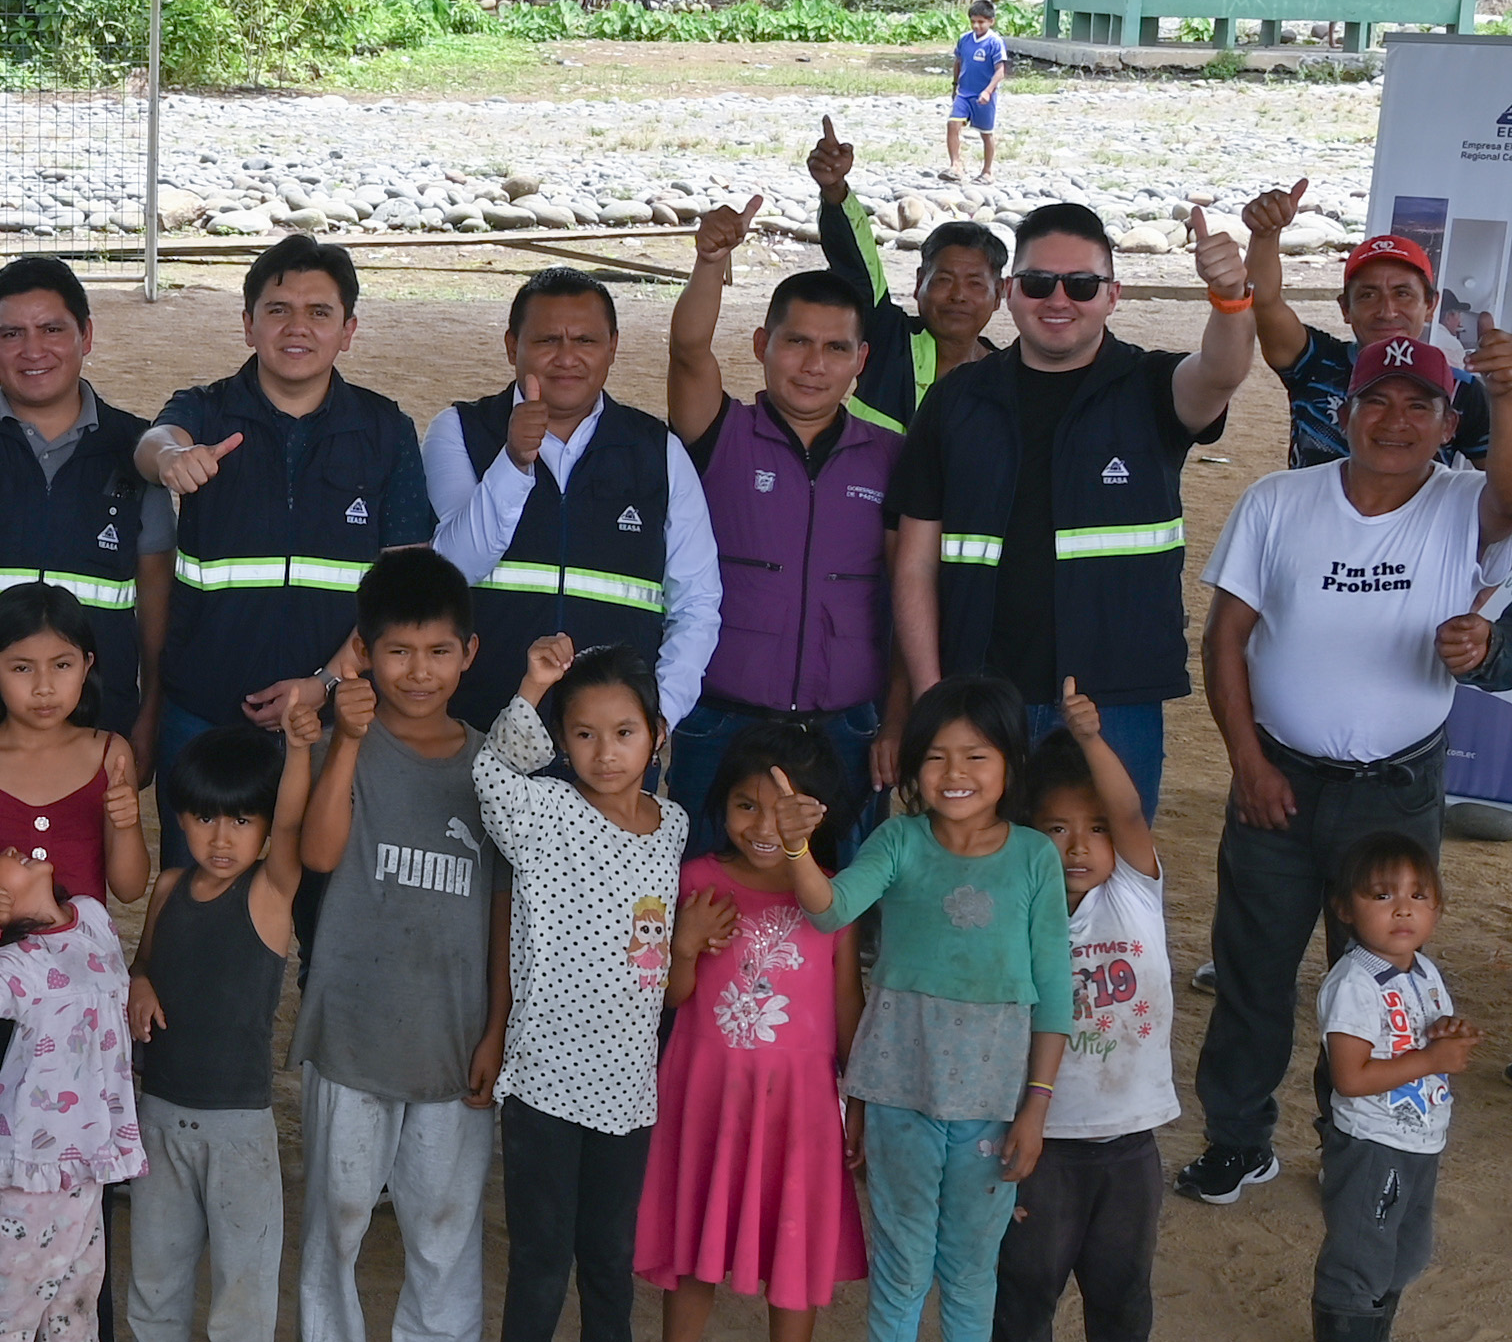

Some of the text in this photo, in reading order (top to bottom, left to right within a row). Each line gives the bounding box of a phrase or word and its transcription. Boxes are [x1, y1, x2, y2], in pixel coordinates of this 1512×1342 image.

[1462, 141, 1502, 151] Empresa
[1460, 151, 1500, 162] Regional
[1330, 561, 1406, 578] I'm the
[1322, 575, 1412, 593] Problem
[375, 843, 473, 897] PUMA
[1072, 940, 1128, 959] STMAS
